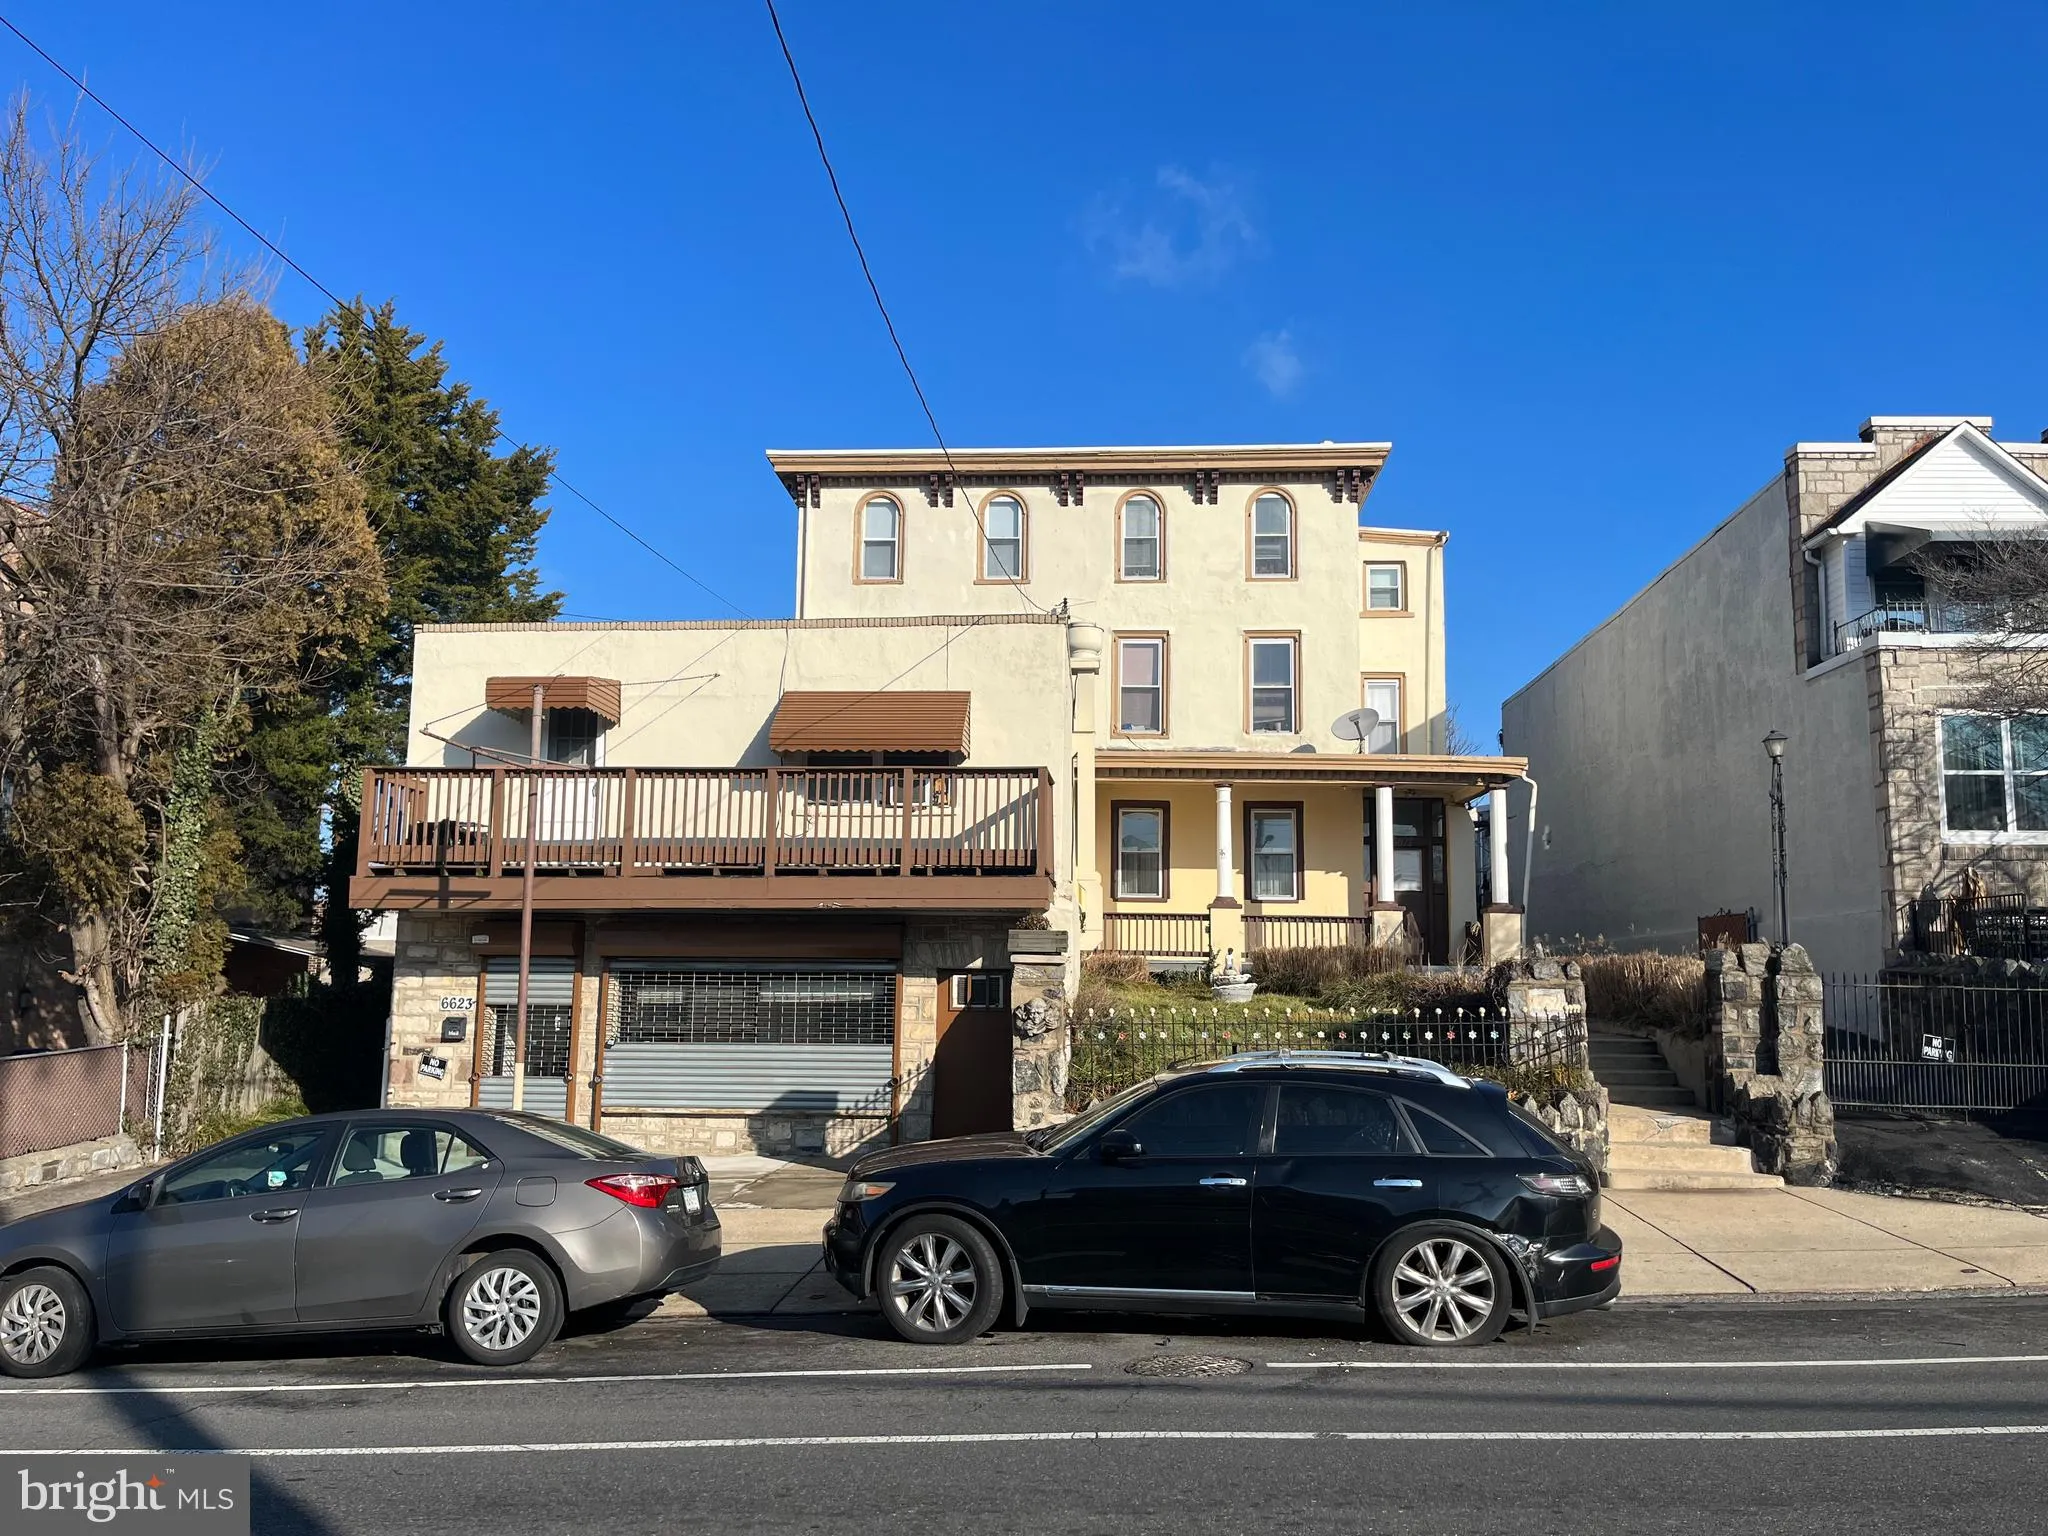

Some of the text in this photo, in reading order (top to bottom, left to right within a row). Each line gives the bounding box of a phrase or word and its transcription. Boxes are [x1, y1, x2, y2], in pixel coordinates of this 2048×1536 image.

[441, 997, 473, 1010] 6623
[1932, 1038, 1942, 1048] NO
[1923, 1046, 1953, 1060] PARKG
[429, 1058, 440, 1067] NO
[420, 1064, 445, 1077] PARKING
